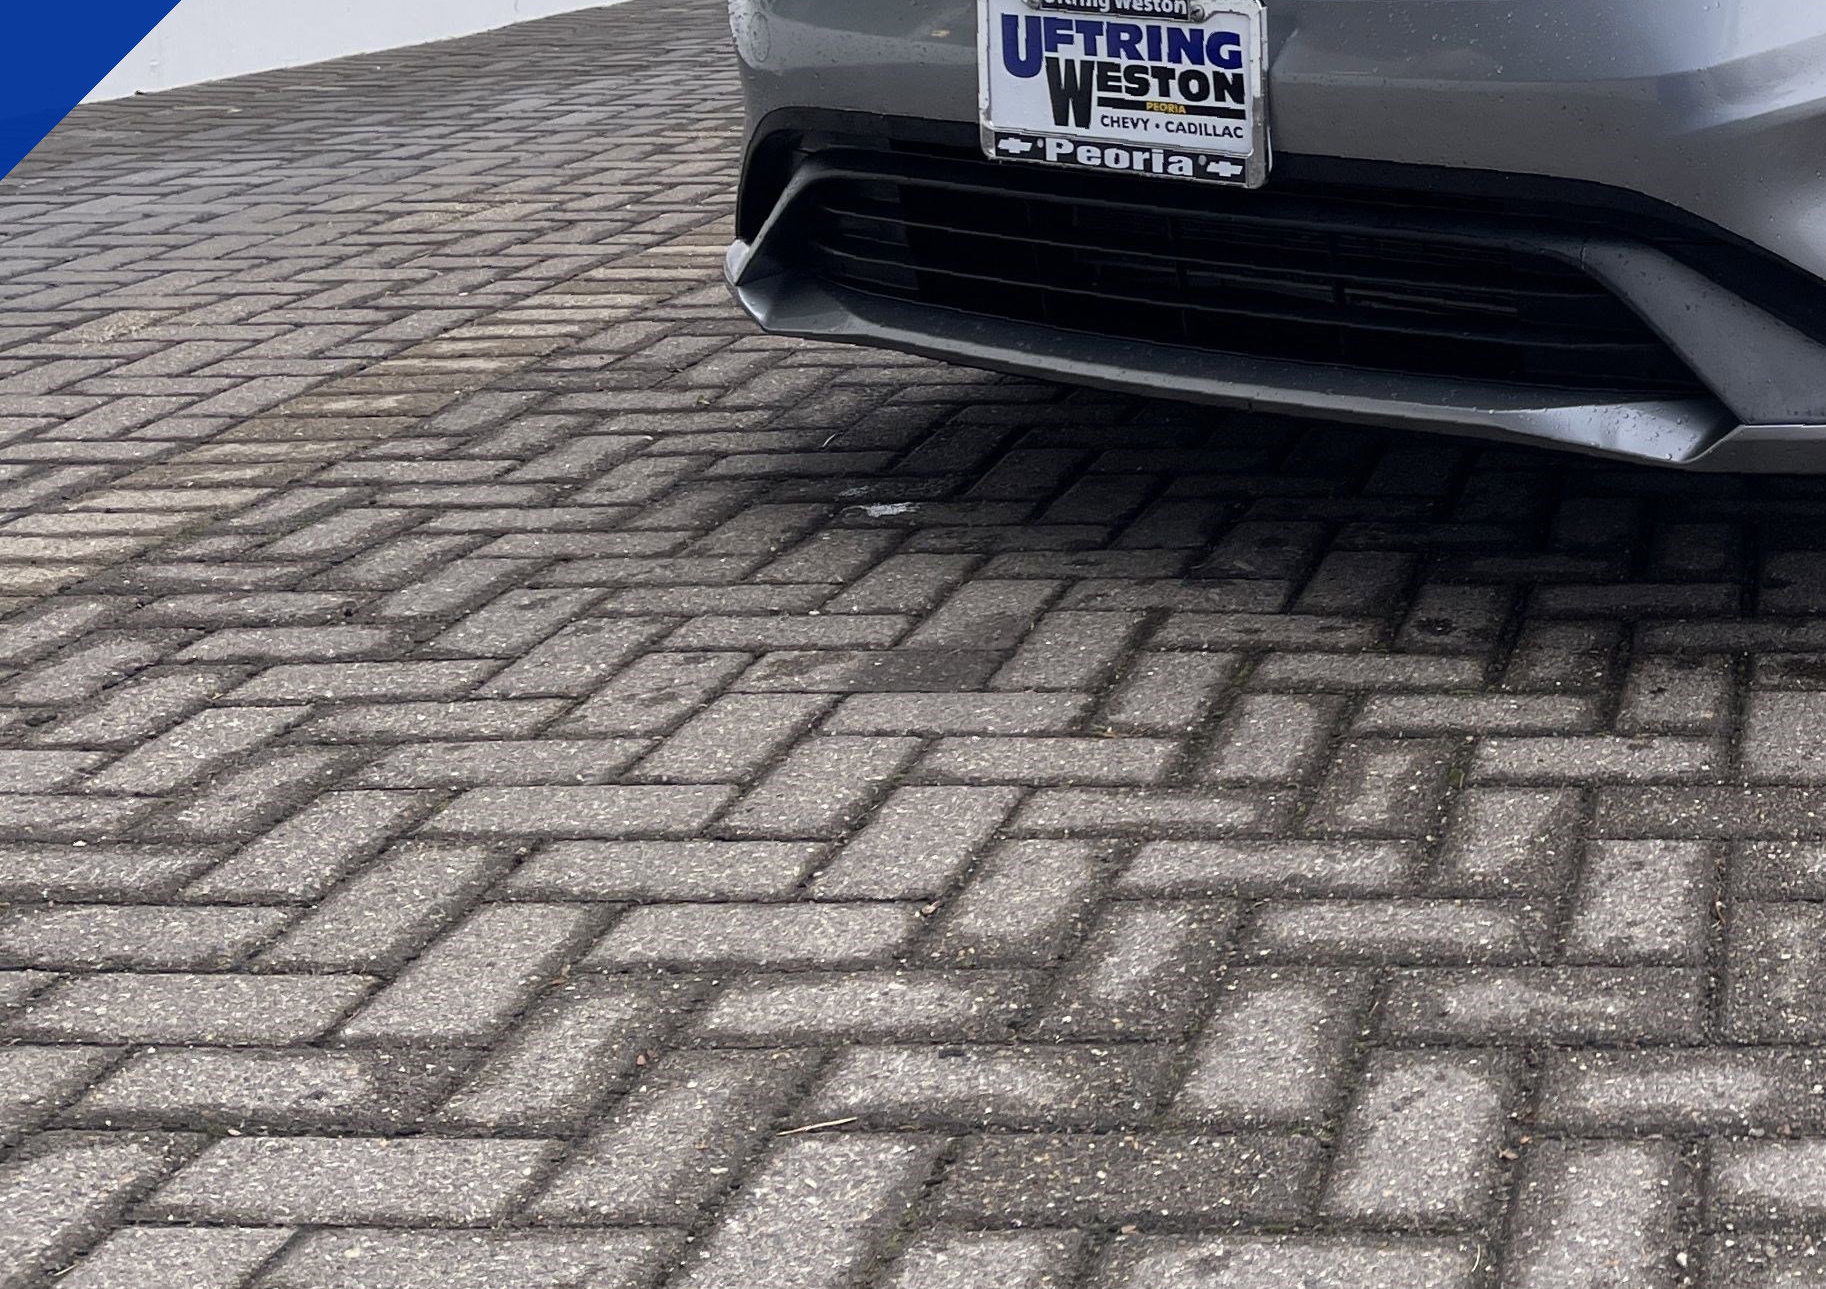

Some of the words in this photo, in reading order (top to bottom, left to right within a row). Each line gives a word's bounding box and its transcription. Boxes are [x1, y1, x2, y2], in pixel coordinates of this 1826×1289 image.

[1001, 13, 1243, 79] UFTRING
[1045, 56, 1246, 129] WESTON
[1146, 101, 1186, 115] PEORIA
[1100, 115, 1150, 131] CHEVY
[1165, 120, 1244, 139] CADILLAC
[1046, 137, 1194, 177] Peoria
